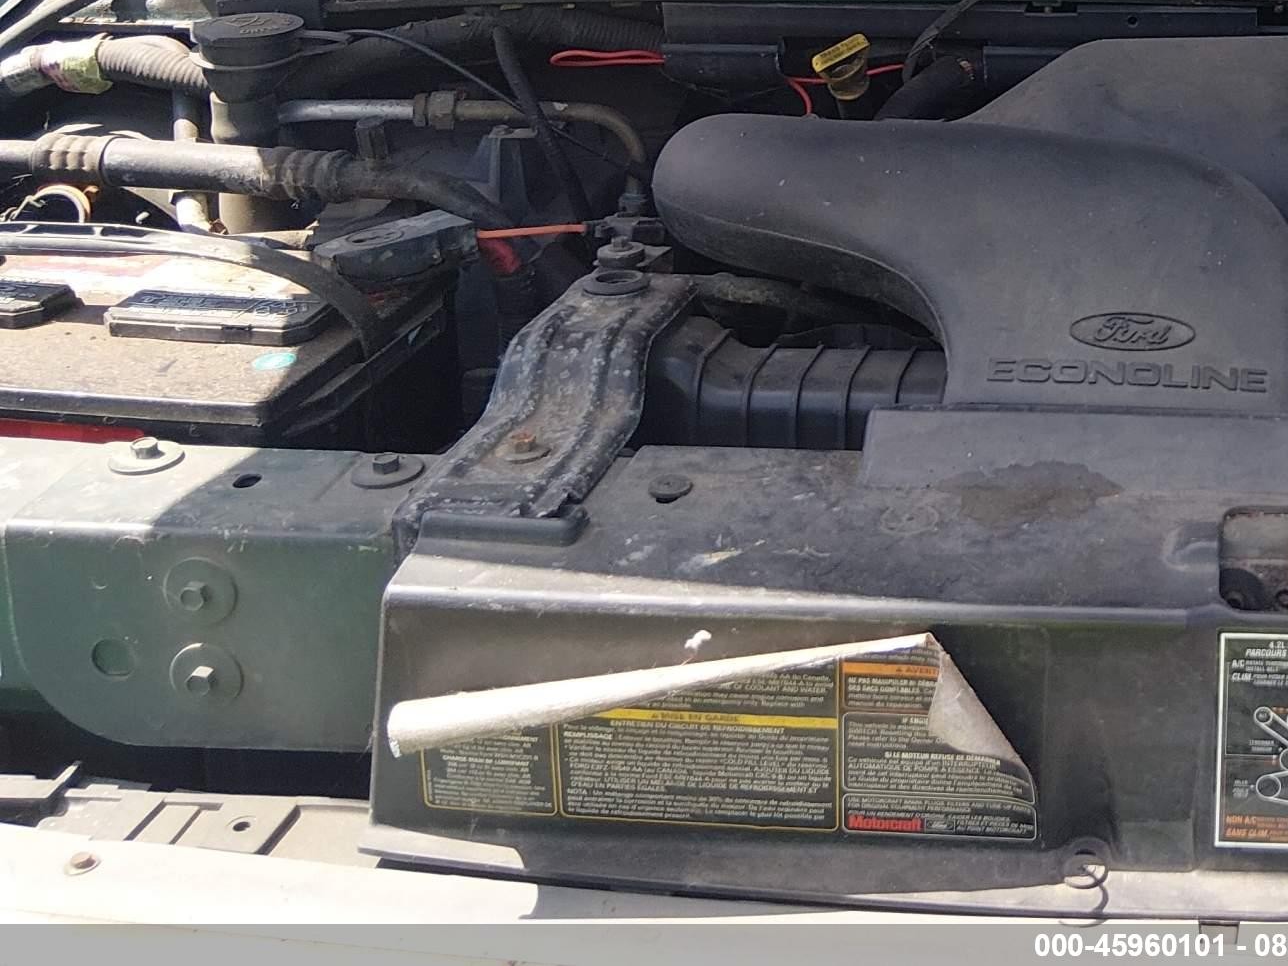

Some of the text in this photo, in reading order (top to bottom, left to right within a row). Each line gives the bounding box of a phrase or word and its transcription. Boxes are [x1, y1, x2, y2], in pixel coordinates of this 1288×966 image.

[1093, 315, 1172, 345] Ford
[987, 358, 1268, 393] ECONOLINE
[1269, 641, 1287, 650] 4.2L
[1245, 648, 1287, 658] PARCOURS
[1231, 659, 1245, 668] A/C
[847, 814, 922, 831] Motorcraft
